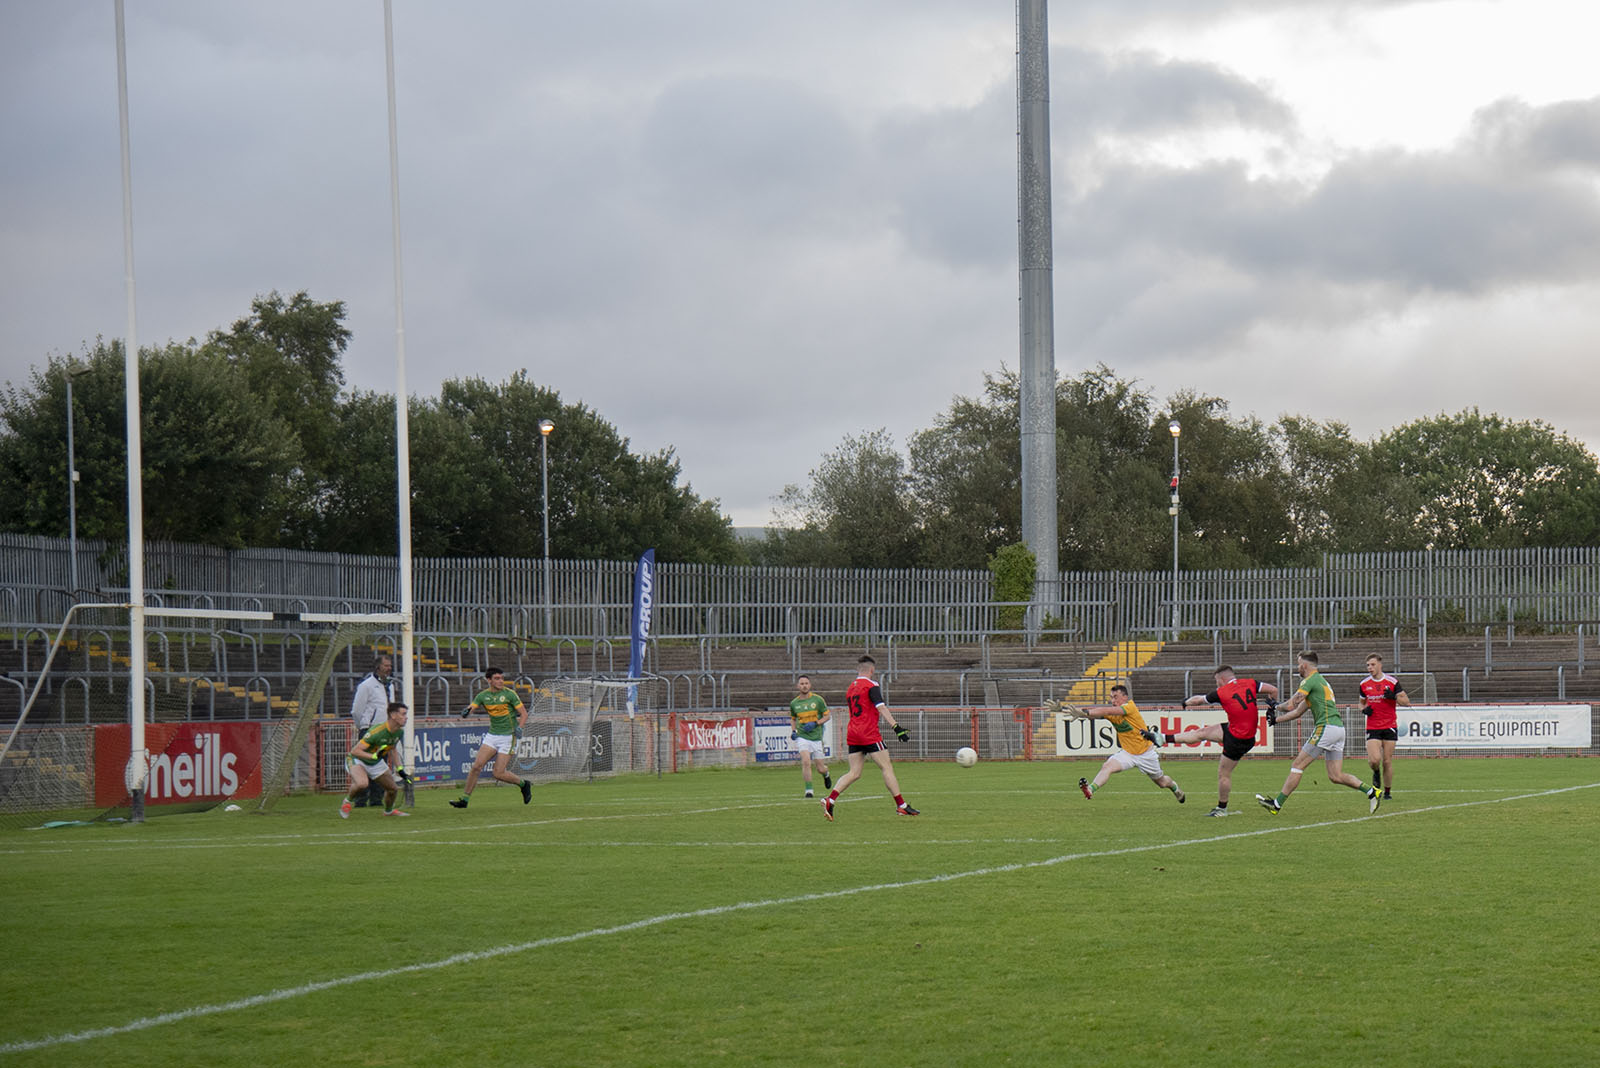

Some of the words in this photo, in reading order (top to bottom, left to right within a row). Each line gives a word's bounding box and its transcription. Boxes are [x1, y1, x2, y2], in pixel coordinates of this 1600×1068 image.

[847, 694, 863, 718] 13
[1232, 687, 1258, 711] 14
[1409, 721, 1444, 738] A&B
[1446, 721, 1475, 738] FIRE
[414, 732, 451, 763] Abac
[765, 736, 788, 751] SCOTTS
